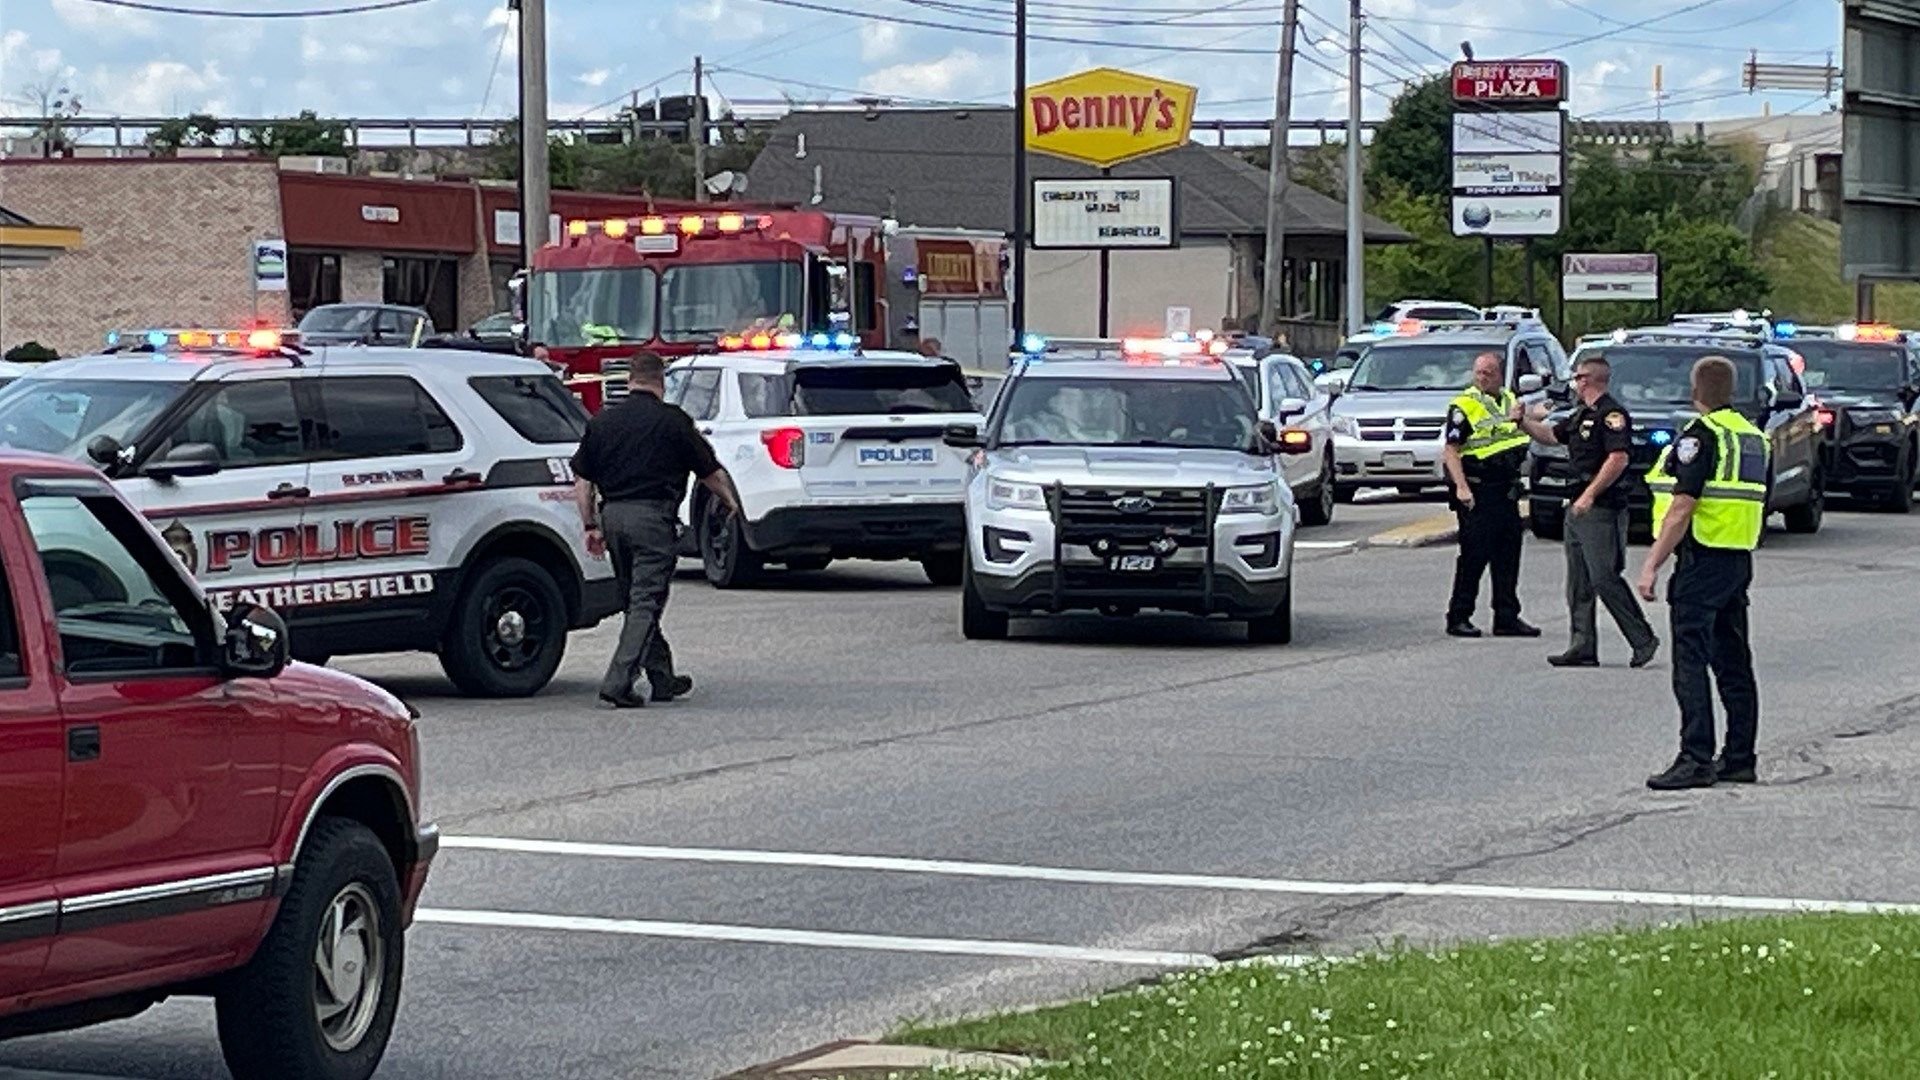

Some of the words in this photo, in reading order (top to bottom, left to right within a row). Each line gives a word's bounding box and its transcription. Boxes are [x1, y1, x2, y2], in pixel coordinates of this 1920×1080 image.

[1474, 80, 1541, 97] PLAZA
[1031, 88, 1176, 137] Denny's
[859, 448, 933, 462] POLICE
[206, 516, 431, 573] POLICE
